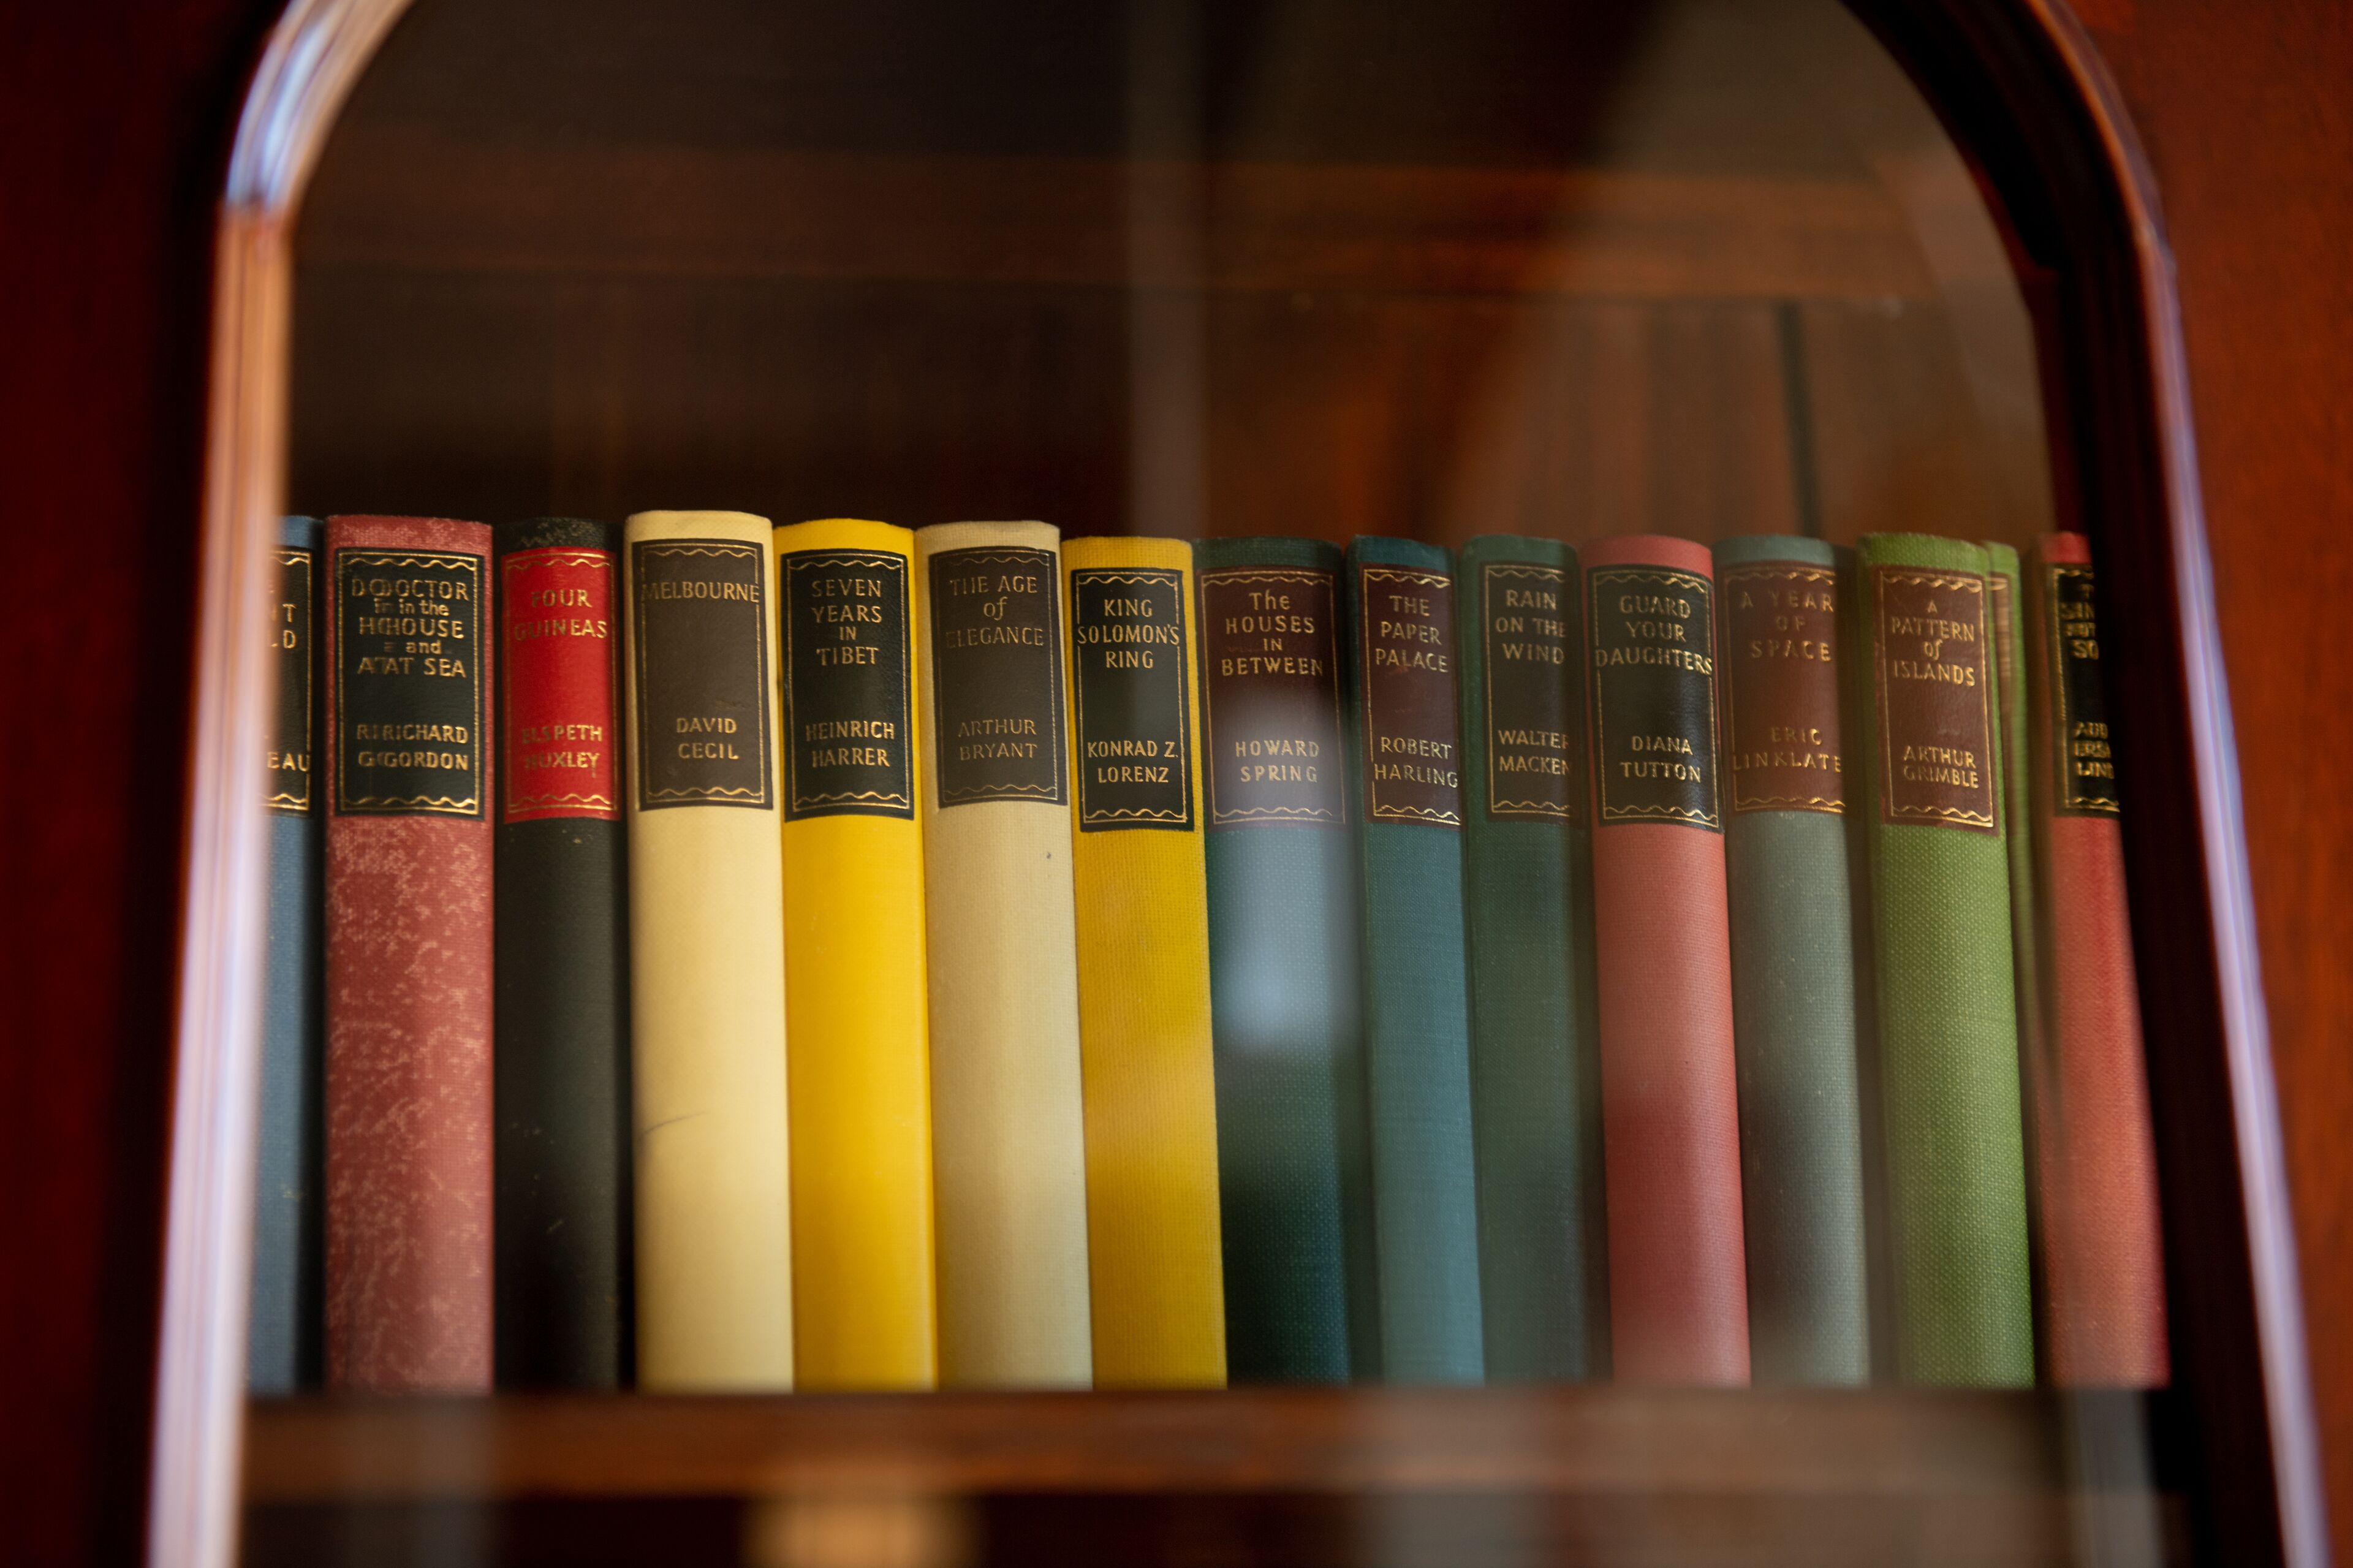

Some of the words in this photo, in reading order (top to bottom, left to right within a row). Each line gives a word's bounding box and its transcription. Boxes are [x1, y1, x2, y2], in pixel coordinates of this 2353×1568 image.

[643, 581, 760, 604] MELBOURNE
[811, 579, 882, 598] SEVEN
[950, 577, 989, 596] THE
[998, 575, 1038, 594] AGE
[419, 600, 450, 616] the
[531, 589, 593, 608] FOUR
[983, 596, 1008, 621] of
[1104, 599, 1153, 617] KING
[1249, 589, 1291, 610] The
[1389, 595, 1430, 616] THE
[1506, 589, 1557, 610] RAIN
[1620, 595, 1691, 619] GUARD
[1741, 591, 1754, 609] A
[1768, 589, 1833, 613] YEAR
[1927, 599, 1938, 613] A
[811, 606, 882, 624] YEARS
[1226, 616, 1315, 635] HOUSES
[1776, 615, 1806, 632] OF
[514, 619, 608, 641] GUINEAS
[839, 626, 856, 640] IN
[946, 627, 1044, 648] ELEGANCE
[1077, 624, 1180, 645] SOLOMON'S
[1381, 621, 1442, 645] PAPER
[1495, 616, 1523, 633] ON
[1533, 618, 1566, 638] THE
[1626, 622, 1686, 643] YOUR
[1892, 616, 1974, 642] PATTERN
[405, 640, 442, 654] and
[1264, 638, 1283, 652] IN
[1502, 644, 1565, 665] WIND
[1750, 640, 1832, 662] SPACE
[1924, 639, 1942, 661] of
[817, 647, 879, 666] TIBET
[1105, 651, 1154, 669] RING
[1221, 658, 1324, 676] BETWEEN
[1376, 648, 1449, 673] PALACE
[1596, 646, 1712, 675] DAUGHTERS
[423, 657, 467, 678] SEA
[1894, 660, 1976, 687] ISLANDS
[522, 724, 602, 744] ELSPETH
[677, 718, 737, 733] DAVID
[806, 721, 894, 741] HEINRICH
[959, 719, 1037, 738] ARTHUR
[1631, 735, 1693, 756] DIANA
[1771, 727, 1822, 746] ERIC
[678, 743, 739, 760] CECIL
[812, 748, 890, 768] HARRER
[960, 743, 1037, 761] BRYANT
[1088, 740, 1158, 759] KONRAD
[1164, 741, 1179, 758] Z.
[1235, 740, 1320, 758] HOWARD
[1381, 737, 1452, 760] ROBERT
[1904, 745, 1977, 769] ARTHUR
[524, 752, 600, 778] HUXLEY
[1620, 762, 1702, 783] TUTTON
[1733, 751, 1841, 773] LINKLATE
[1098, 767, 1169, 784] LORENZ
[1240, 765, 1318, 783] SPRING
[1374, 764, 1458, 789] HARLING
[1904, 765, 1980, 789] GRIMBLE
